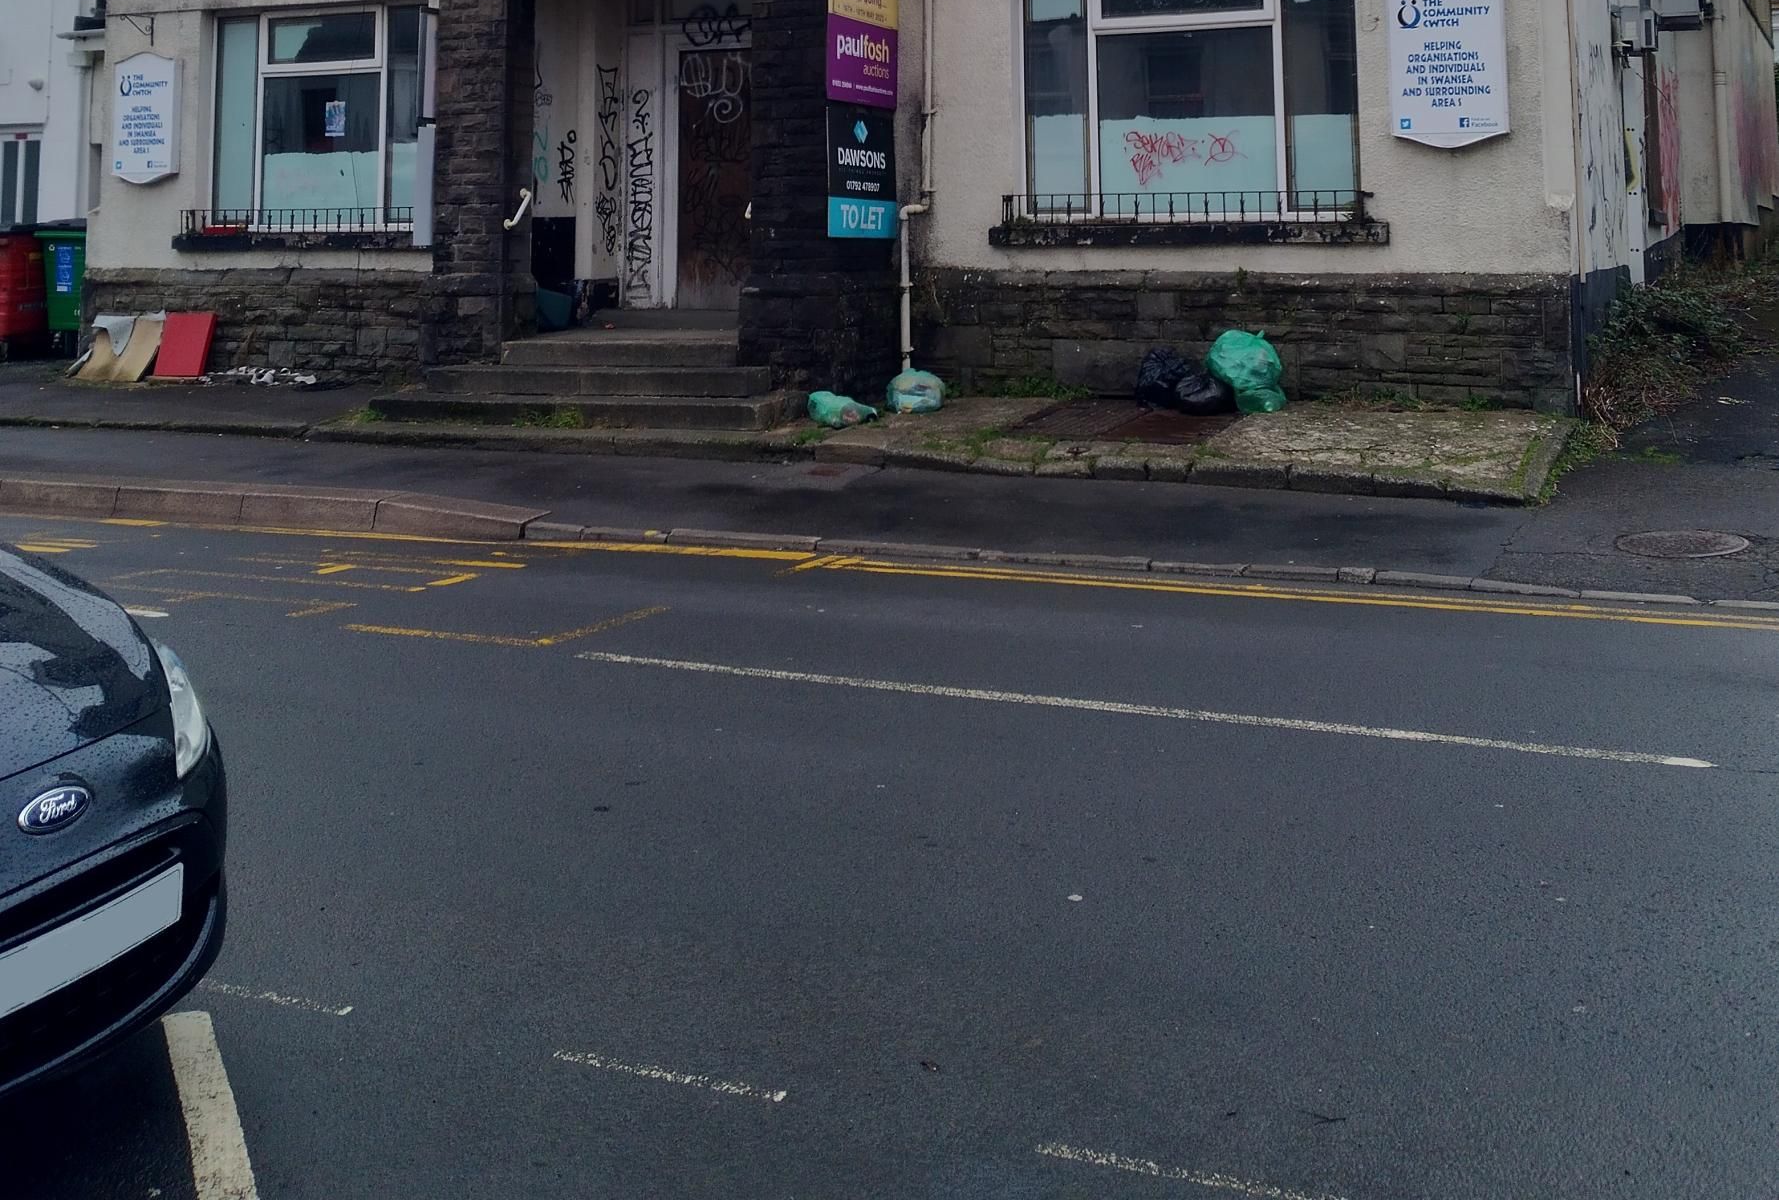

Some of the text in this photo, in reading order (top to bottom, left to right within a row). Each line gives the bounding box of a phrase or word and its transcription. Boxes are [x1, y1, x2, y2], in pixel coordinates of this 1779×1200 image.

[1423, 6, 1490, 17] COMMUNITY
[1423, 18, 1460, 28] CWTCH
[837, 34, 889, 64] paulfosh
[1424, 41, 1462, 51] HELPING
[1408, 52, 1479, 63] ORGANISATIONS
[863, 64, 890, 79] auctions
[1406, 63, 1486, 74] AND INDIVIDUALS
[1418, 75, 1473, 85] IN SWANSEA
[1402, 86, 1491, 97] AND SURROUNDING
[837, 147, 886, 169] DAWSONS
[846, 180, 861, 191] 01792
[840, 204, 885, 230] TO LET
[39, 793, 77, 823] Ford
